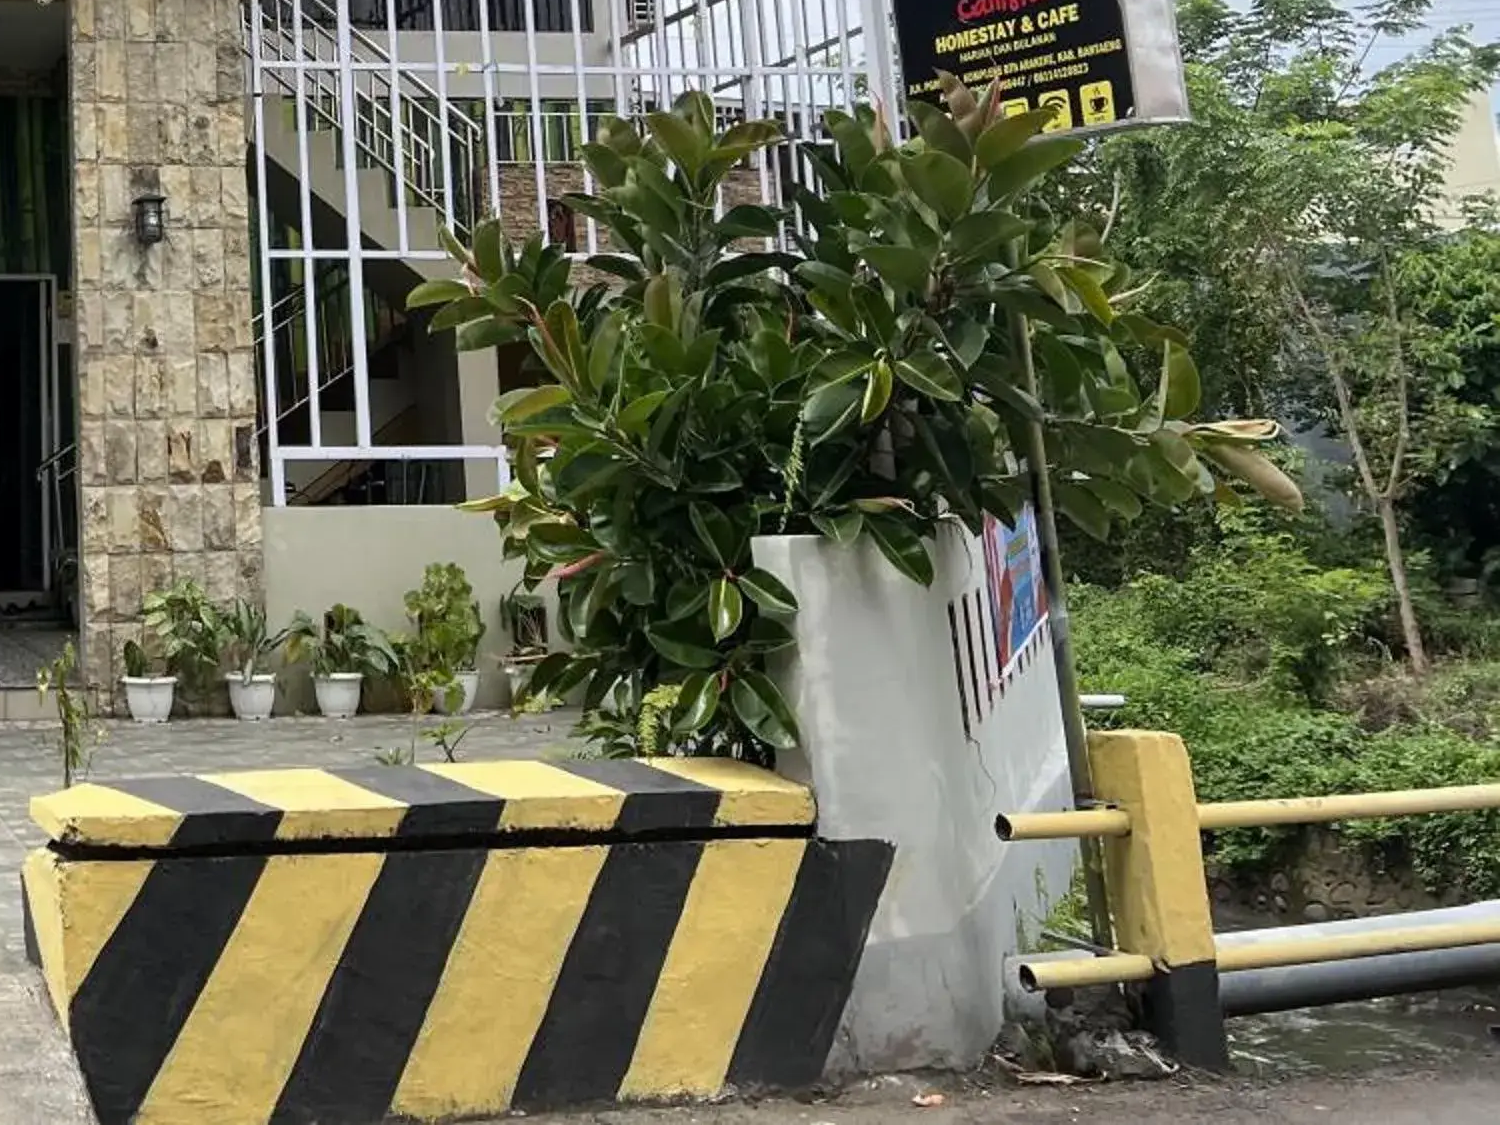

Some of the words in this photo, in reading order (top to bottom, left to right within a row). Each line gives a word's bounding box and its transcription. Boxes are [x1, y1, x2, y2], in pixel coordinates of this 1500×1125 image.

[935, 19, 1016, 54] HOMESTAY
[1020, 14, 1035, 34] &
[1037, 2, 1080, 30] CAFE
